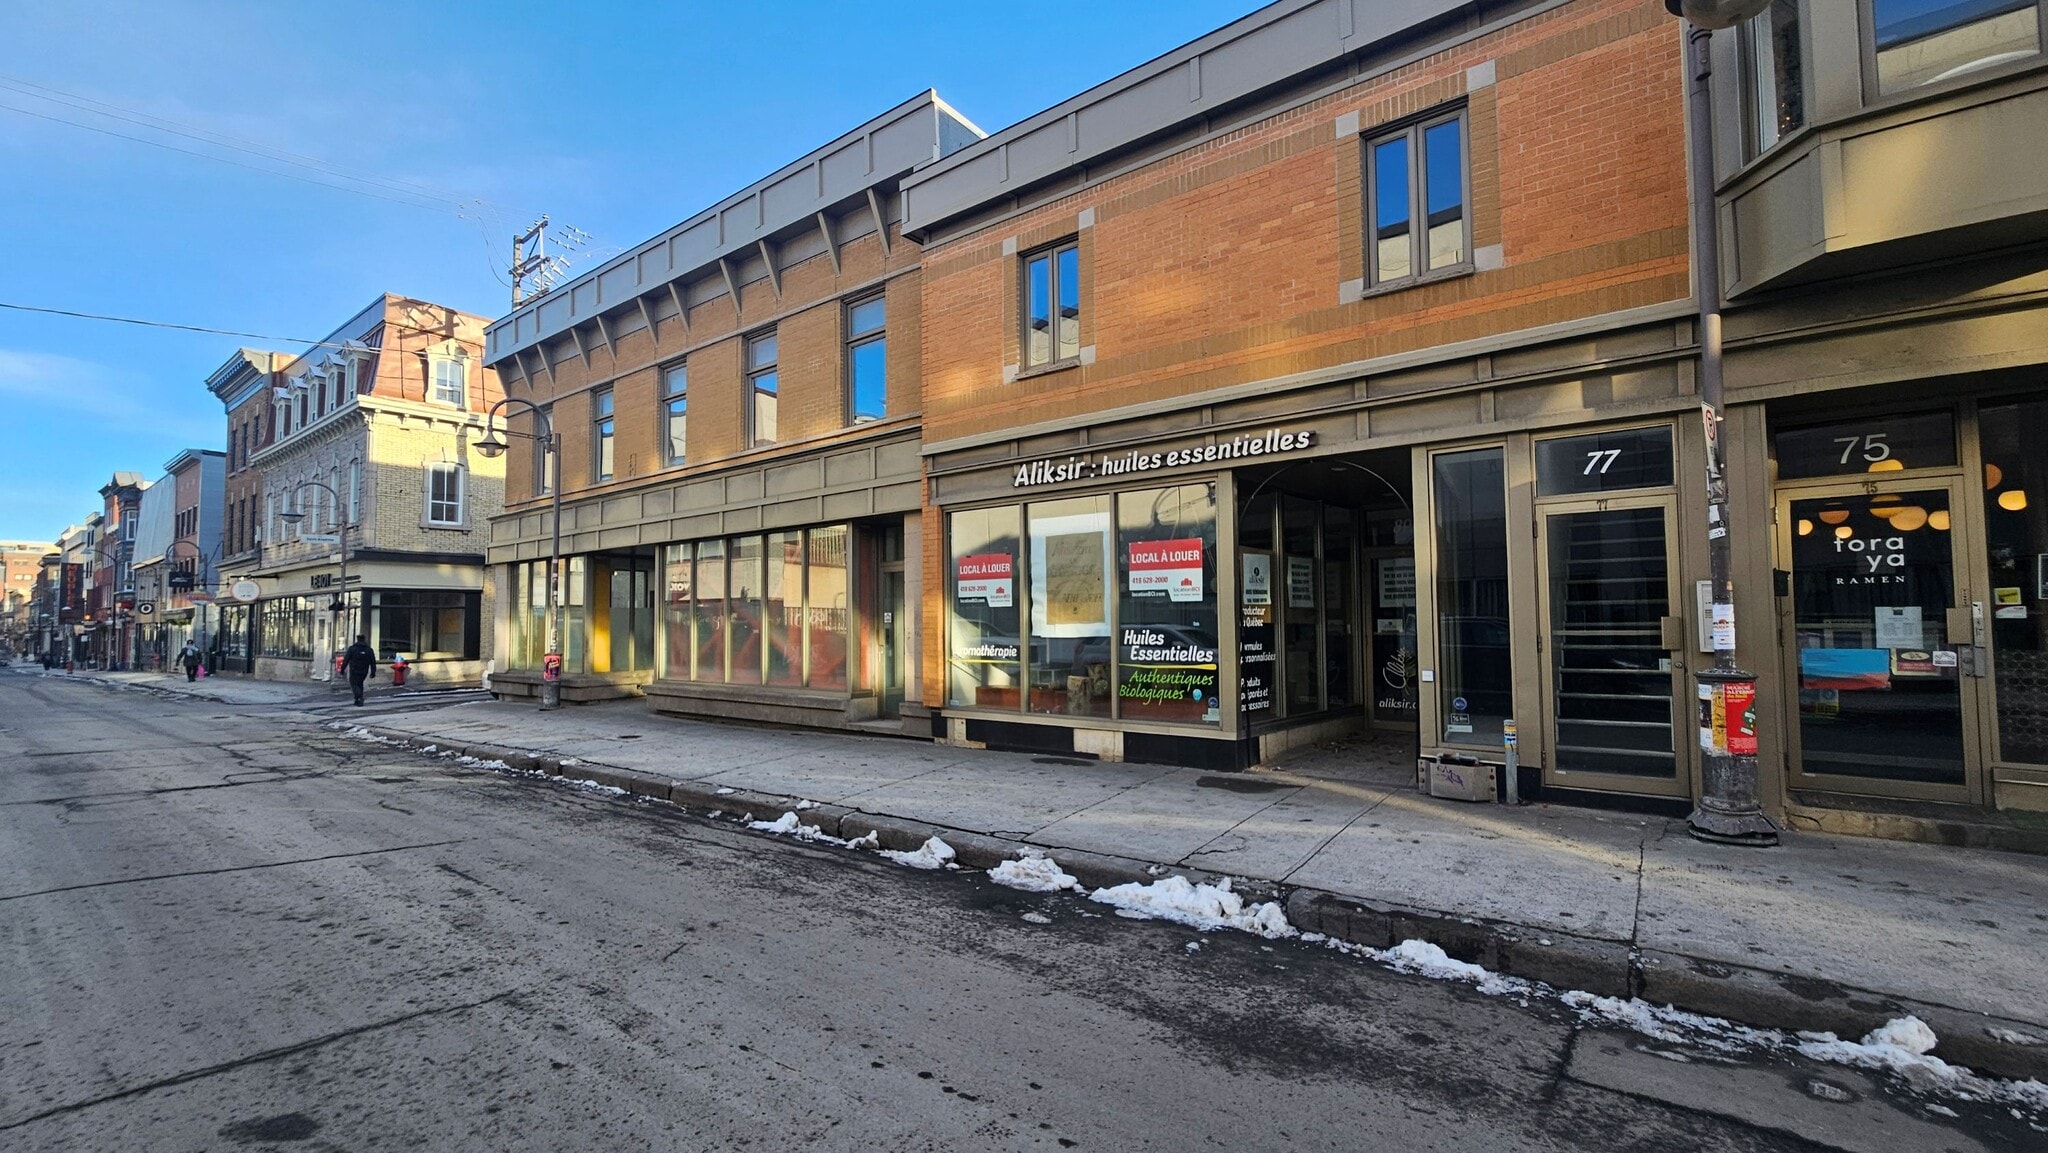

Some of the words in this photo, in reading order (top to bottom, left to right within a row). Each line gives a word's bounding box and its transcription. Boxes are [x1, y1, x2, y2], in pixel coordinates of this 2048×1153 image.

[1833, 433, 1890, 464] 75
[1014, 456, 1086, 488] Aliksir
[1102, 451, 1162, 477] huiles
[1166, 429, 1310, 466] essentielles
[1583, 449, 1622, 475] 77
[1862, 482, 1879, 494] 75
[1596, 499, 1608, 511] 77
[1833, 536, 1905, 552] tora
[1131, 552, 1159, 564] LOCAL
[1161, 549, 1168, 562] À
[1169, 550, 1200, 562] LOUER
[1866, 553, 1905, 573] ya
[959, 564, 981, 575] LOCAL
[981, 562, 987, 574] À
[988, 563, 1010, 573] LOUER
[1836, 575, 1905, 585] RAMEN
[1123, 629, 1165, 646] Huiles
[1130, 645, 1214, 662] Essentielles
[1129, 668, 1214, 692] Authentiques
[1119, 684, 1185, 706] Biologiques
